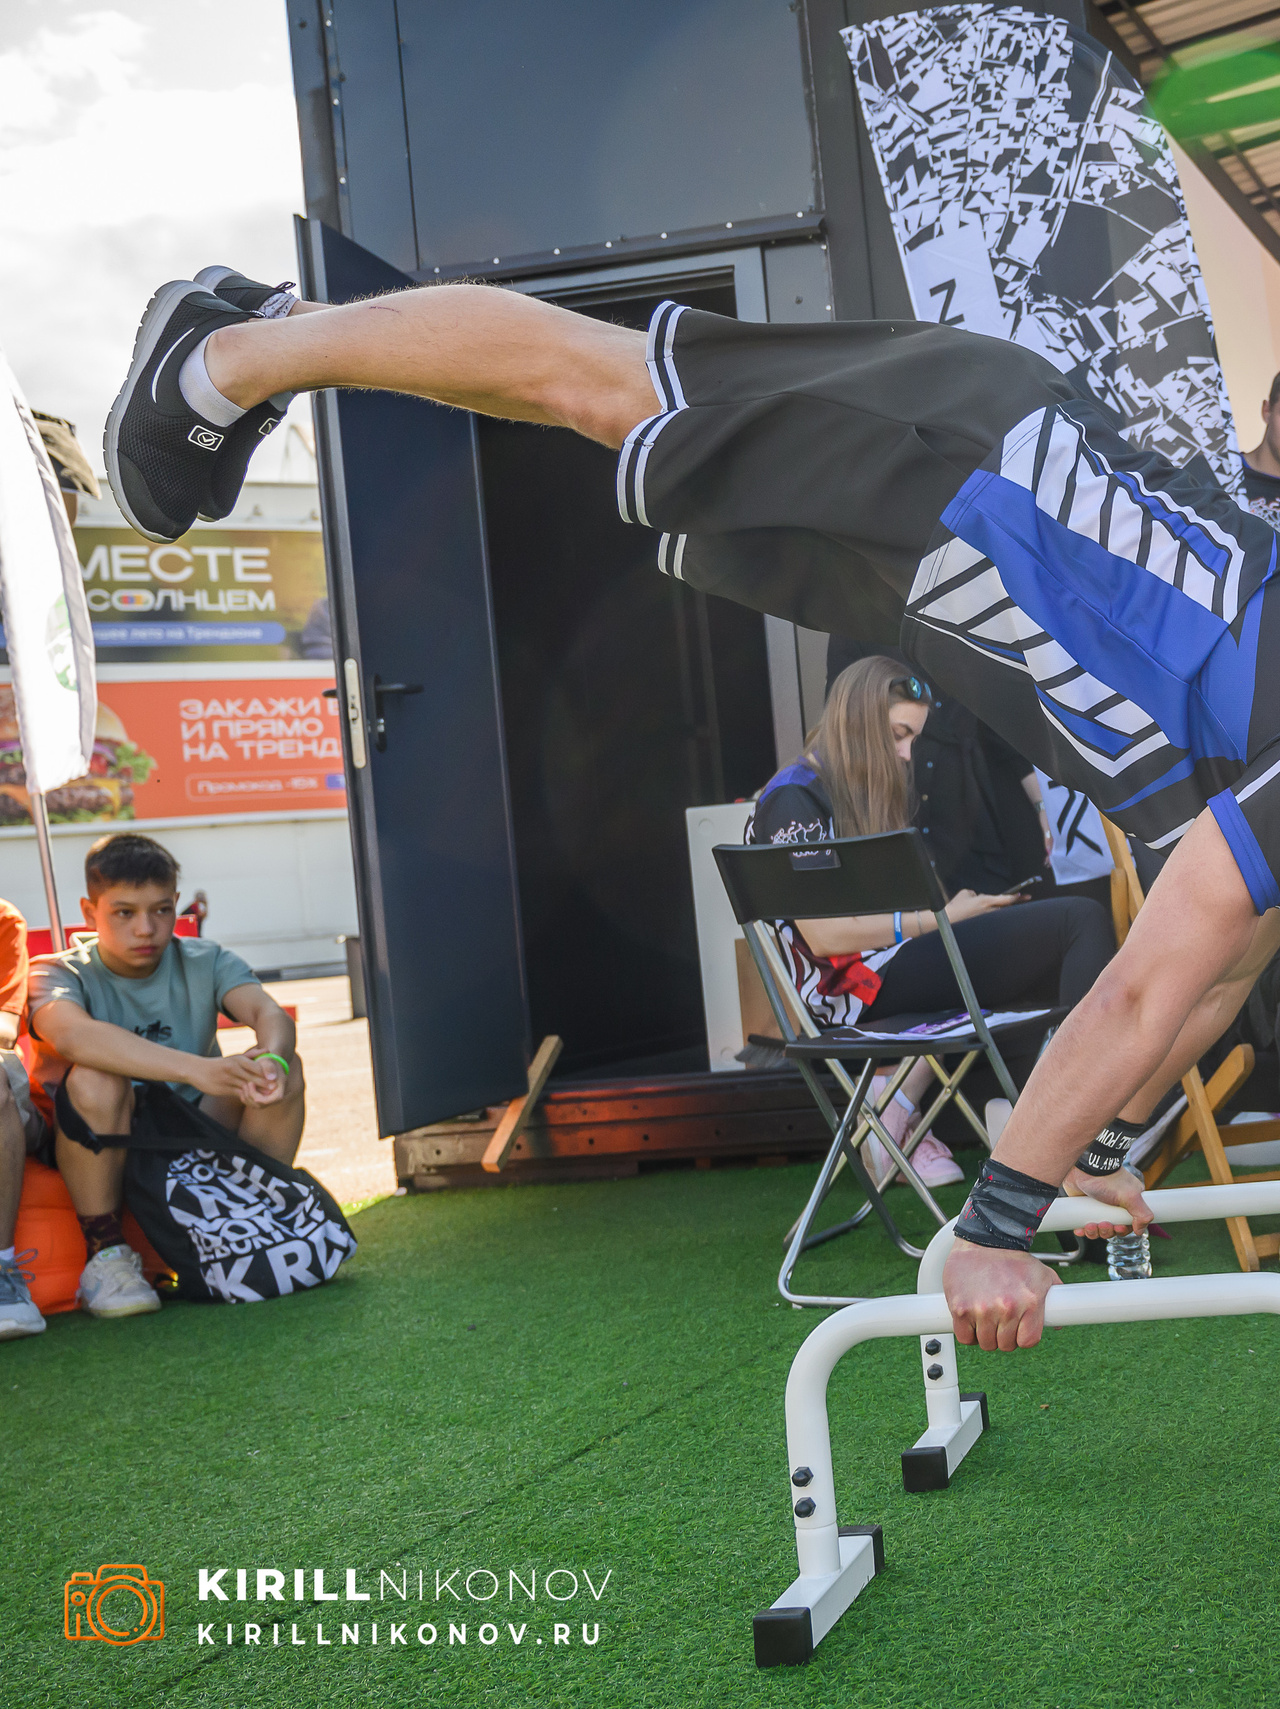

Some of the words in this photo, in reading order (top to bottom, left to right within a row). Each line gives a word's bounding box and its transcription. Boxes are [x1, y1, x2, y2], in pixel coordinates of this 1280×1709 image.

[179, 697, 321, 720] ЗАКАЖИ
[181, 720, 206, 742] И
[212, 717, 325, 740] ПРЯМО
[182, 741, 229, 763] НА
